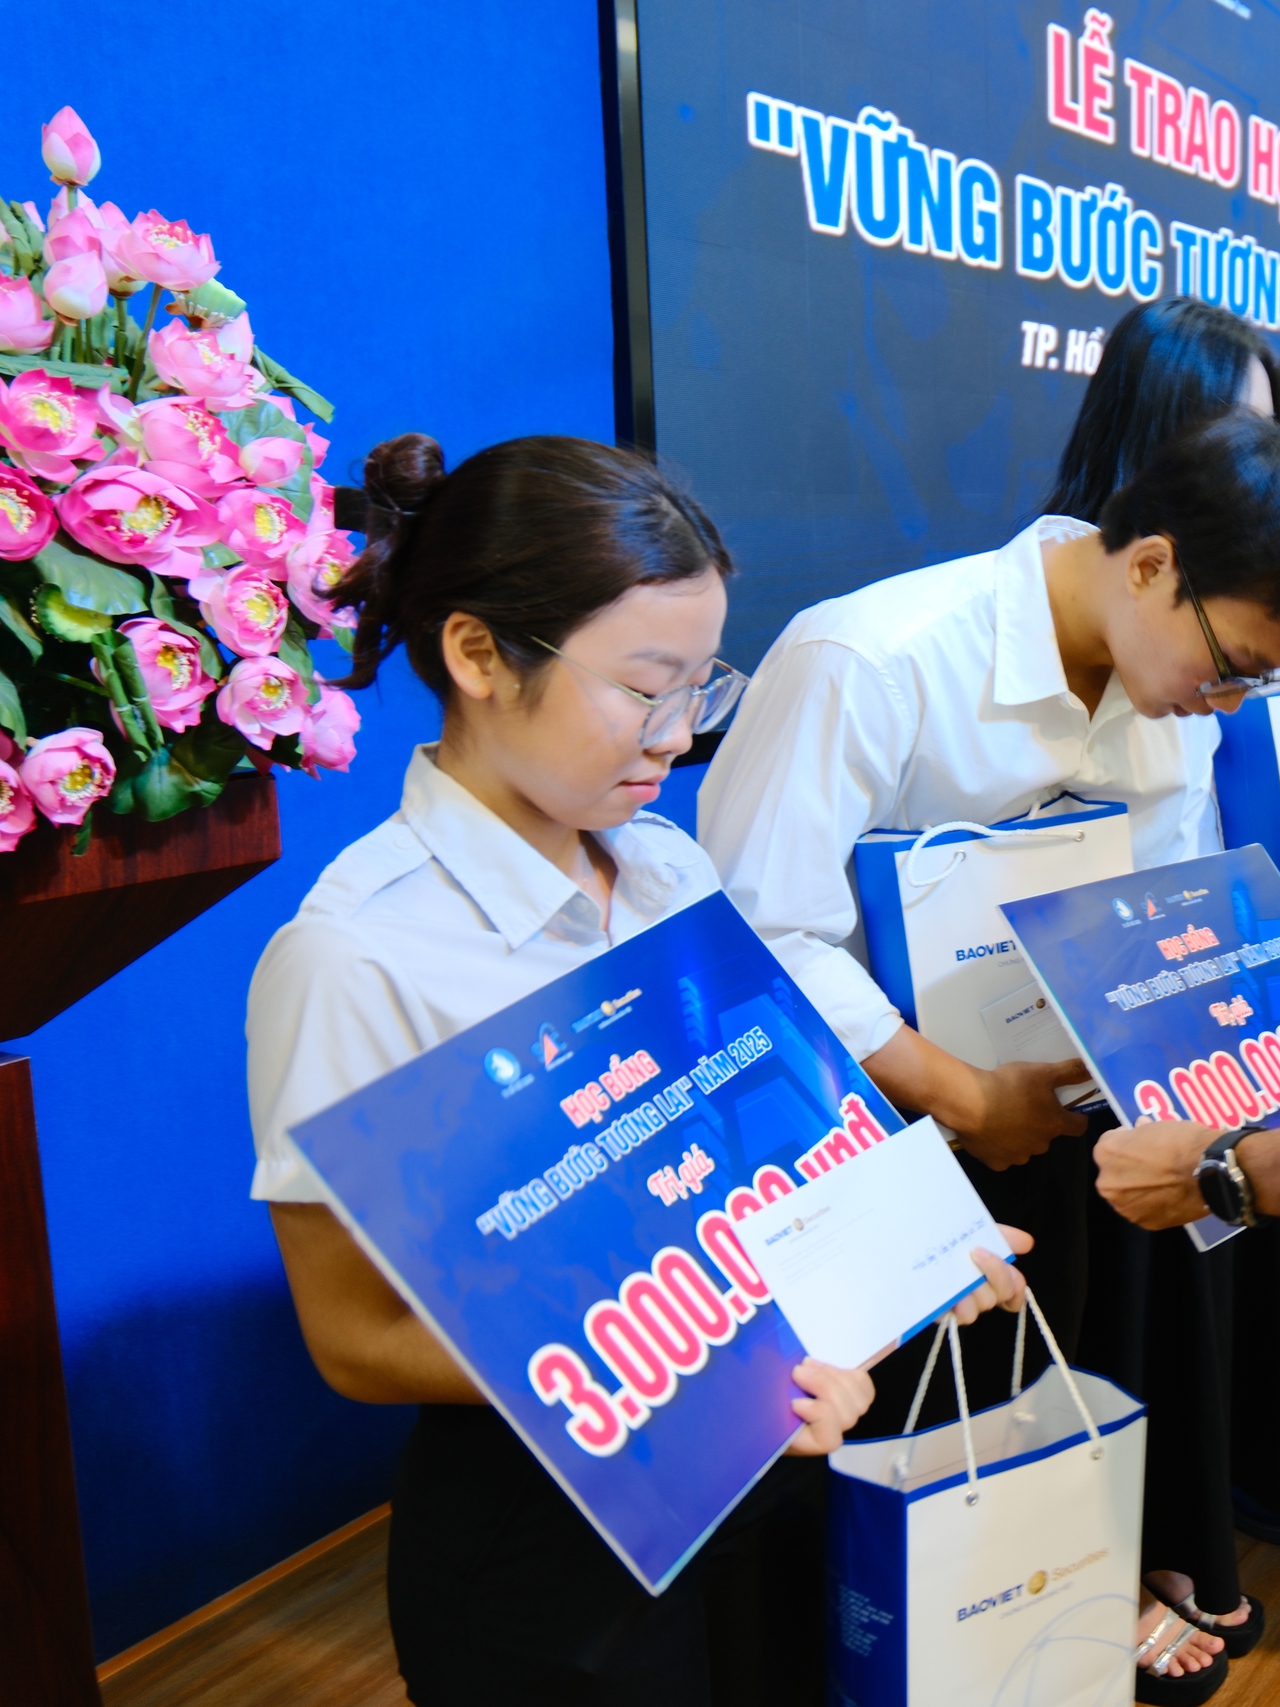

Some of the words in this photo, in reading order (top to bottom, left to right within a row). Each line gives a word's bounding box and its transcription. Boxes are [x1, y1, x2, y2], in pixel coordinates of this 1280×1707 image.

[1047, 8, 1115, 144] LỄ
[1124, 57, 1241, 188] TRAO
[747, 91, 1001, 270] "VỮNG
[1015, 173, 1163, 302] BƯỚC
[1021, 320, 1060, 370] TP.
[543, 1142, 609, 1201] BƯỚC
[594, 1101, 667, 1163] TƯƠNG
[689, 1054, 740, 1096] NĂM
[727, 1025, 773, 1070] 2025
[559, 1080, 611, 1129] HỌC
[598, 1049, 662, 1103] BỔNG
[646, 1164, 689, 1207] Trị
[677, 1142, 716, 1195] giá
[956, 1583, 1025, 1623] BAOVIET
